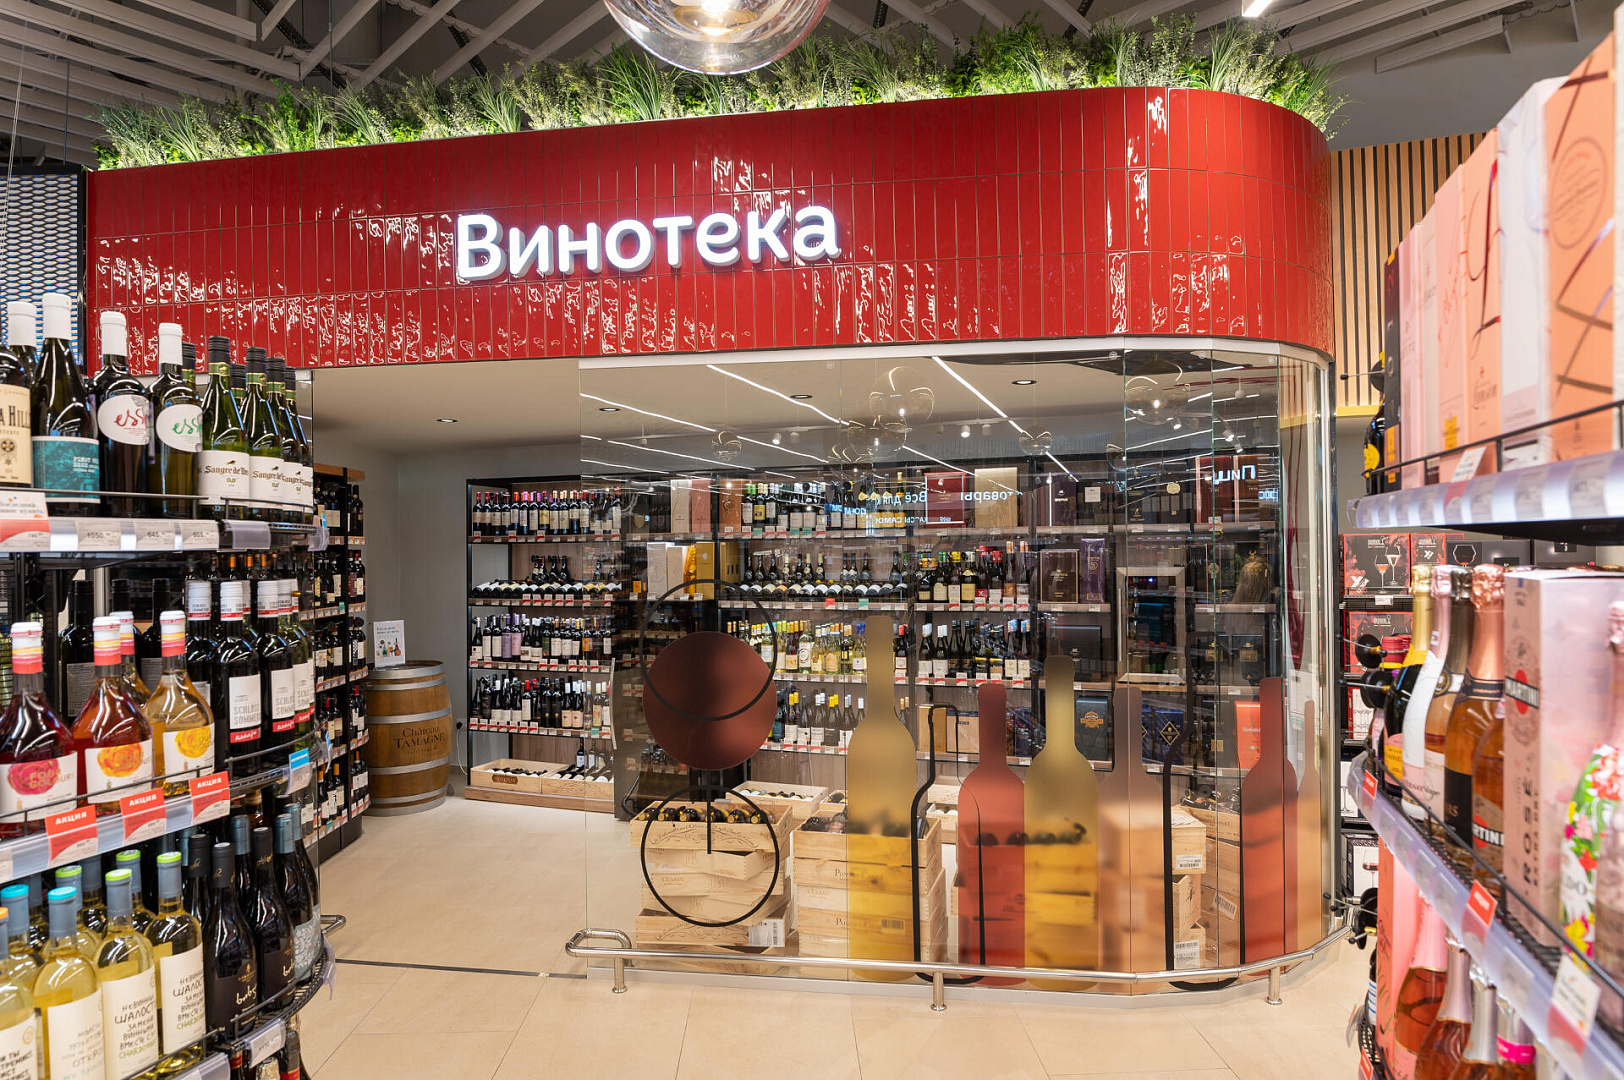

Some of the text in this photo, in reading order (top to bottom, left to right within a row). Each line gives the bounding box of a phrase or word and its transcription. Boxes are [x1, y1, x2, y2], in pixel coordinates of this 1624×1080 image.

[456, 204, 841, 281] Винотека
[204, 465, 232, 475] Sangre
[252, 470, 276, 480] Sangre
[394, 732, 444, 749] TAMAGNE
[197, 777, 222, 789] АКЦИЯ
[129, 794, 157, 807] АКЦИЯ
[55, 811, 87, 825] АКЦИЯ
